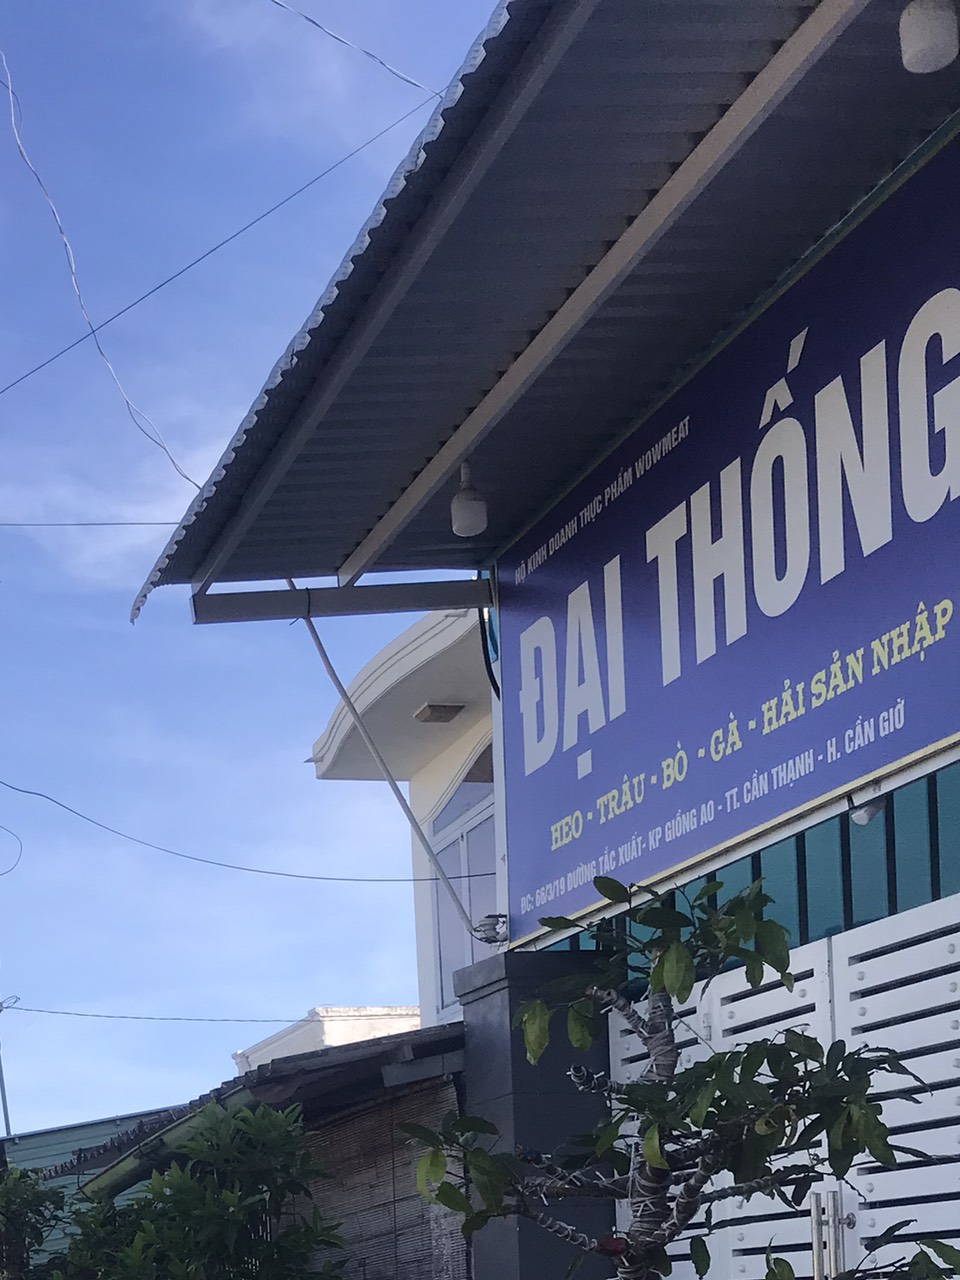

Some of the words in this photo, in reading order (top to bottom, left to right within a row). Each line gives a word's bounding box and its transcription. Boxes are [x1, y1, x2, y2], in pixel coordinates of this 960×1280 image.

[519, 554, 627, 780] ĐẠI
[645, 287, 960, 688] THỐNG
[527, 543, 548, 575] KINH
[548, 516, 578, 556] DOANH
[579, 494, 603, 528] THỰC
[634, 415, 690, 479] WOWMEAT
[535, 876, 566, 907] 66/3/19
[598, 846, 616, 875] TẮC
[648, 826, 662, 852] KP
[665, 809, 698, 843] GIỒNG
[700, 800, 714, 826] AO
[743, 769, 769, 804] CẦN
[771, 748, 814, 790] THẠNH
[844, 715, 875, 754] CẦN
[878, 697, 905, 737] GIỜ
[550, 810, 583, 851] HEO
[596, 773, 645, 825] TRÂU
[661, 740, 688, 789] BÒ
[710, 711, 743, 762] GÀ
[761, 678, 805, 735] HẢI
[810, 648, 864, 710] SẢN
[871, 598, 954, 676] NHẬP
